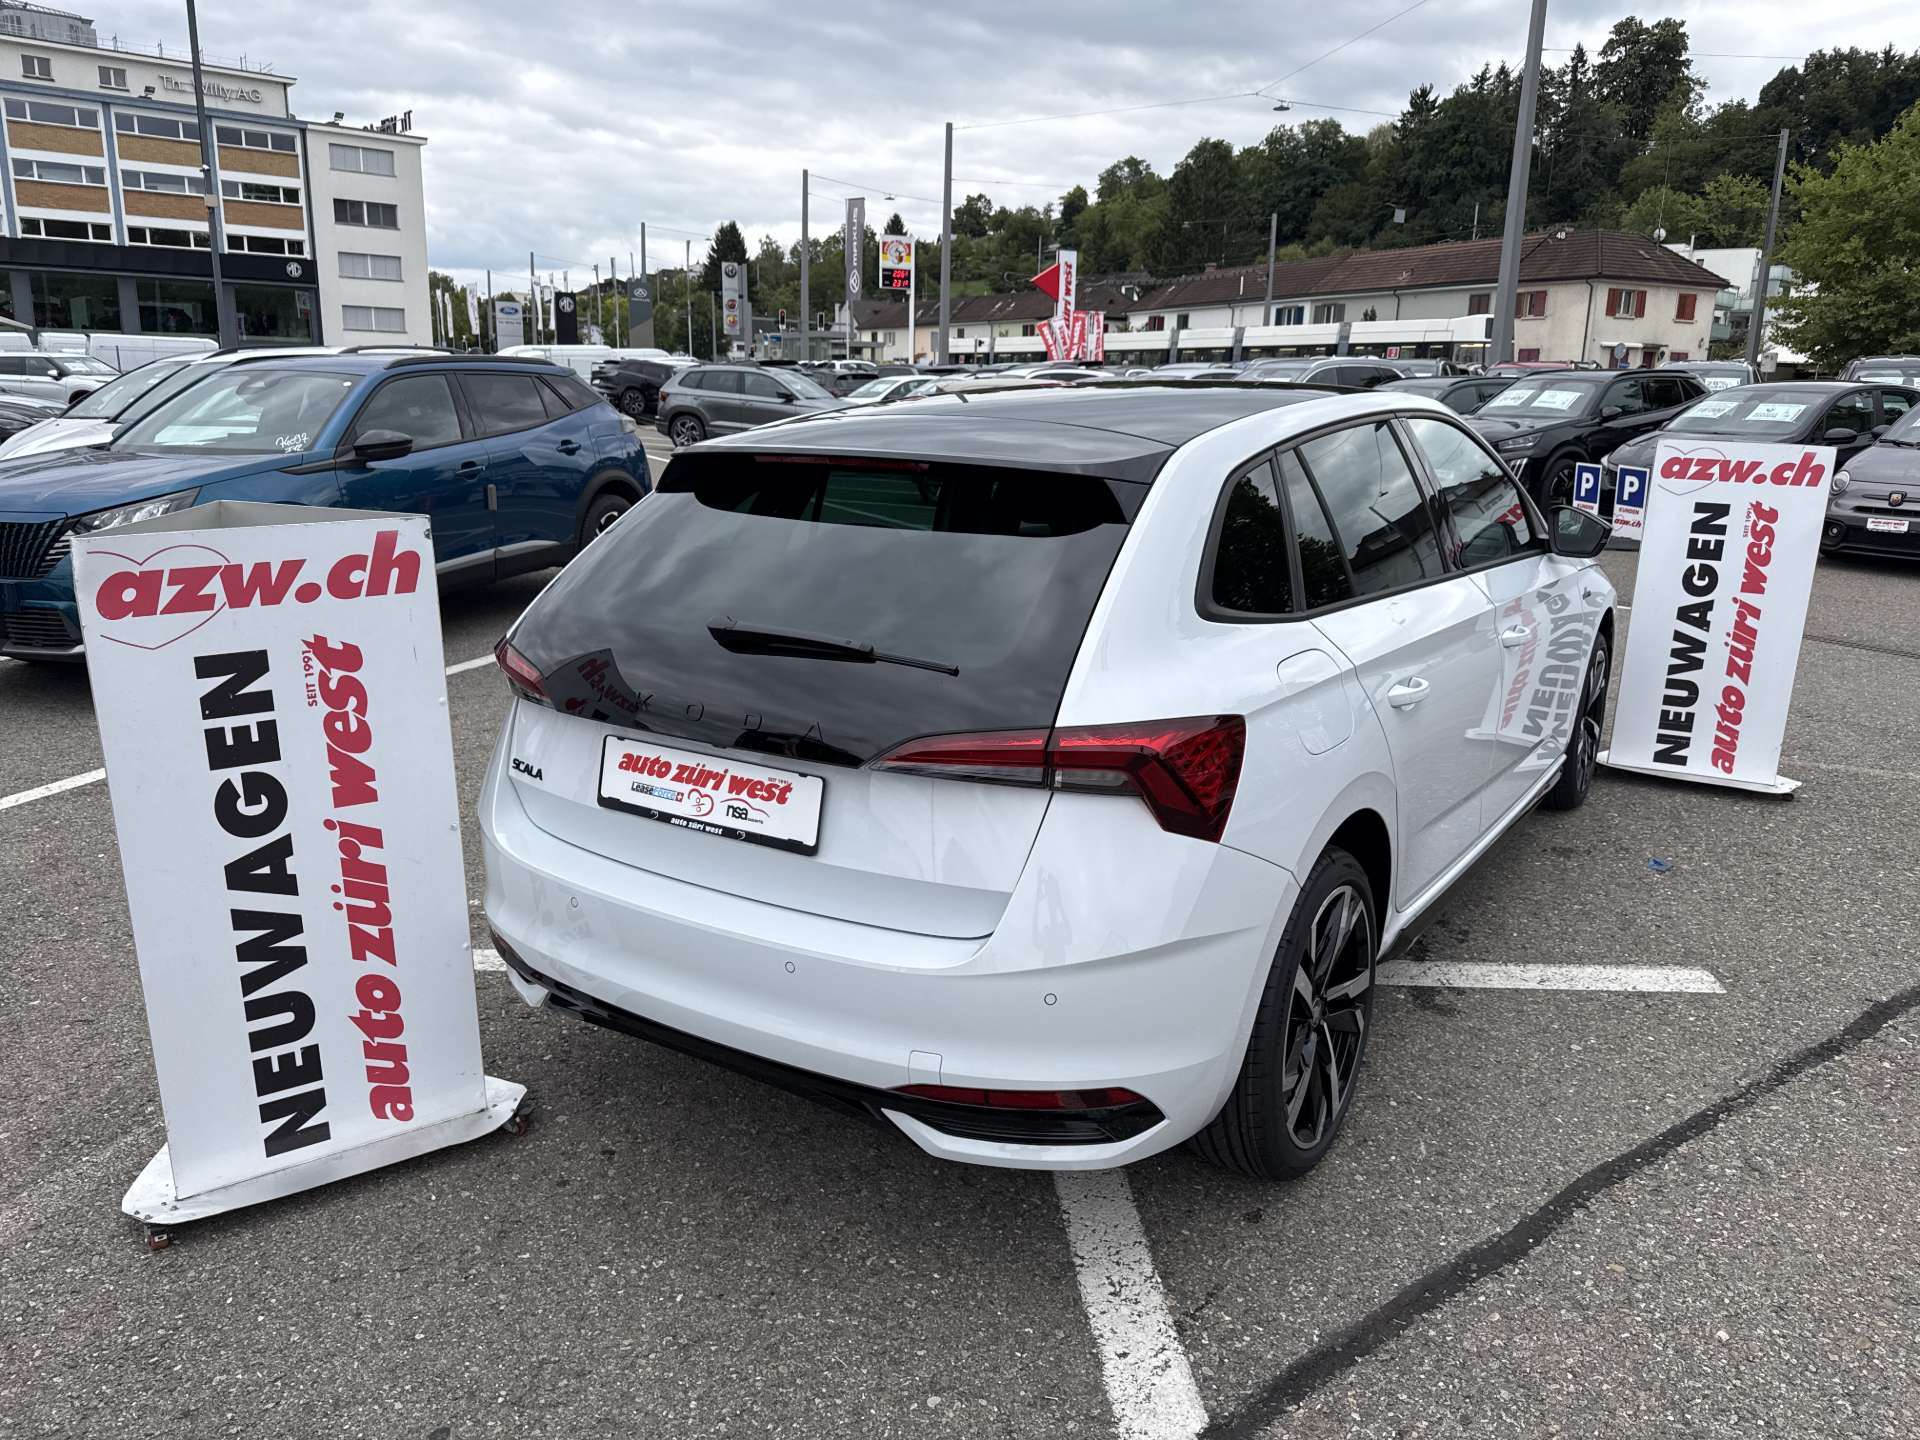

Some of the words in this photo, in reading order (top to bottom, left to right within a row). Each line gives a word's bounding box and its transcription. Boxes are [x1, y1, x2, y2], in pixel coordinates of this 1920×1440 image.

[236, 86, 262, 103] AG
[1580, 472, 1594, 497] P
[1659, 451, 1826, 487] azw.ch
[1623, 475, 1640, 501] P
[1614, 518, 1642, 529] azw.ch
[1619, 507, 1640, 515] KUNDEN
[1740, 500, 1779, 595] west
[95, 529, 422, 621] azw.ch
[1652, 501, 1731, 767] NEUWAGEN
[1724, 596, 1762, 687] züri
[301, 649, 314, 679] 1991
[306, 682, 318, 707] SEIT
[300, 633, 379, 809] west
[1711, 685, 1746, 775] auto
[511, 757, 543, 781] SCALA
[618, 752, 672, 779] auto
[670, 763, 729, 791] züri
[727, 774, 793, 805] west
[670, 817, 688, 827] auto
[688, 821, 705, 831] züri
[705, 825, 723, 835] west
[726, 804, 749, 821] nsa
[193, 649, 332, 1159] NEUWAGEN
[323, 818, 398, 967] züri
[347, 973, 415, 1122] auto
